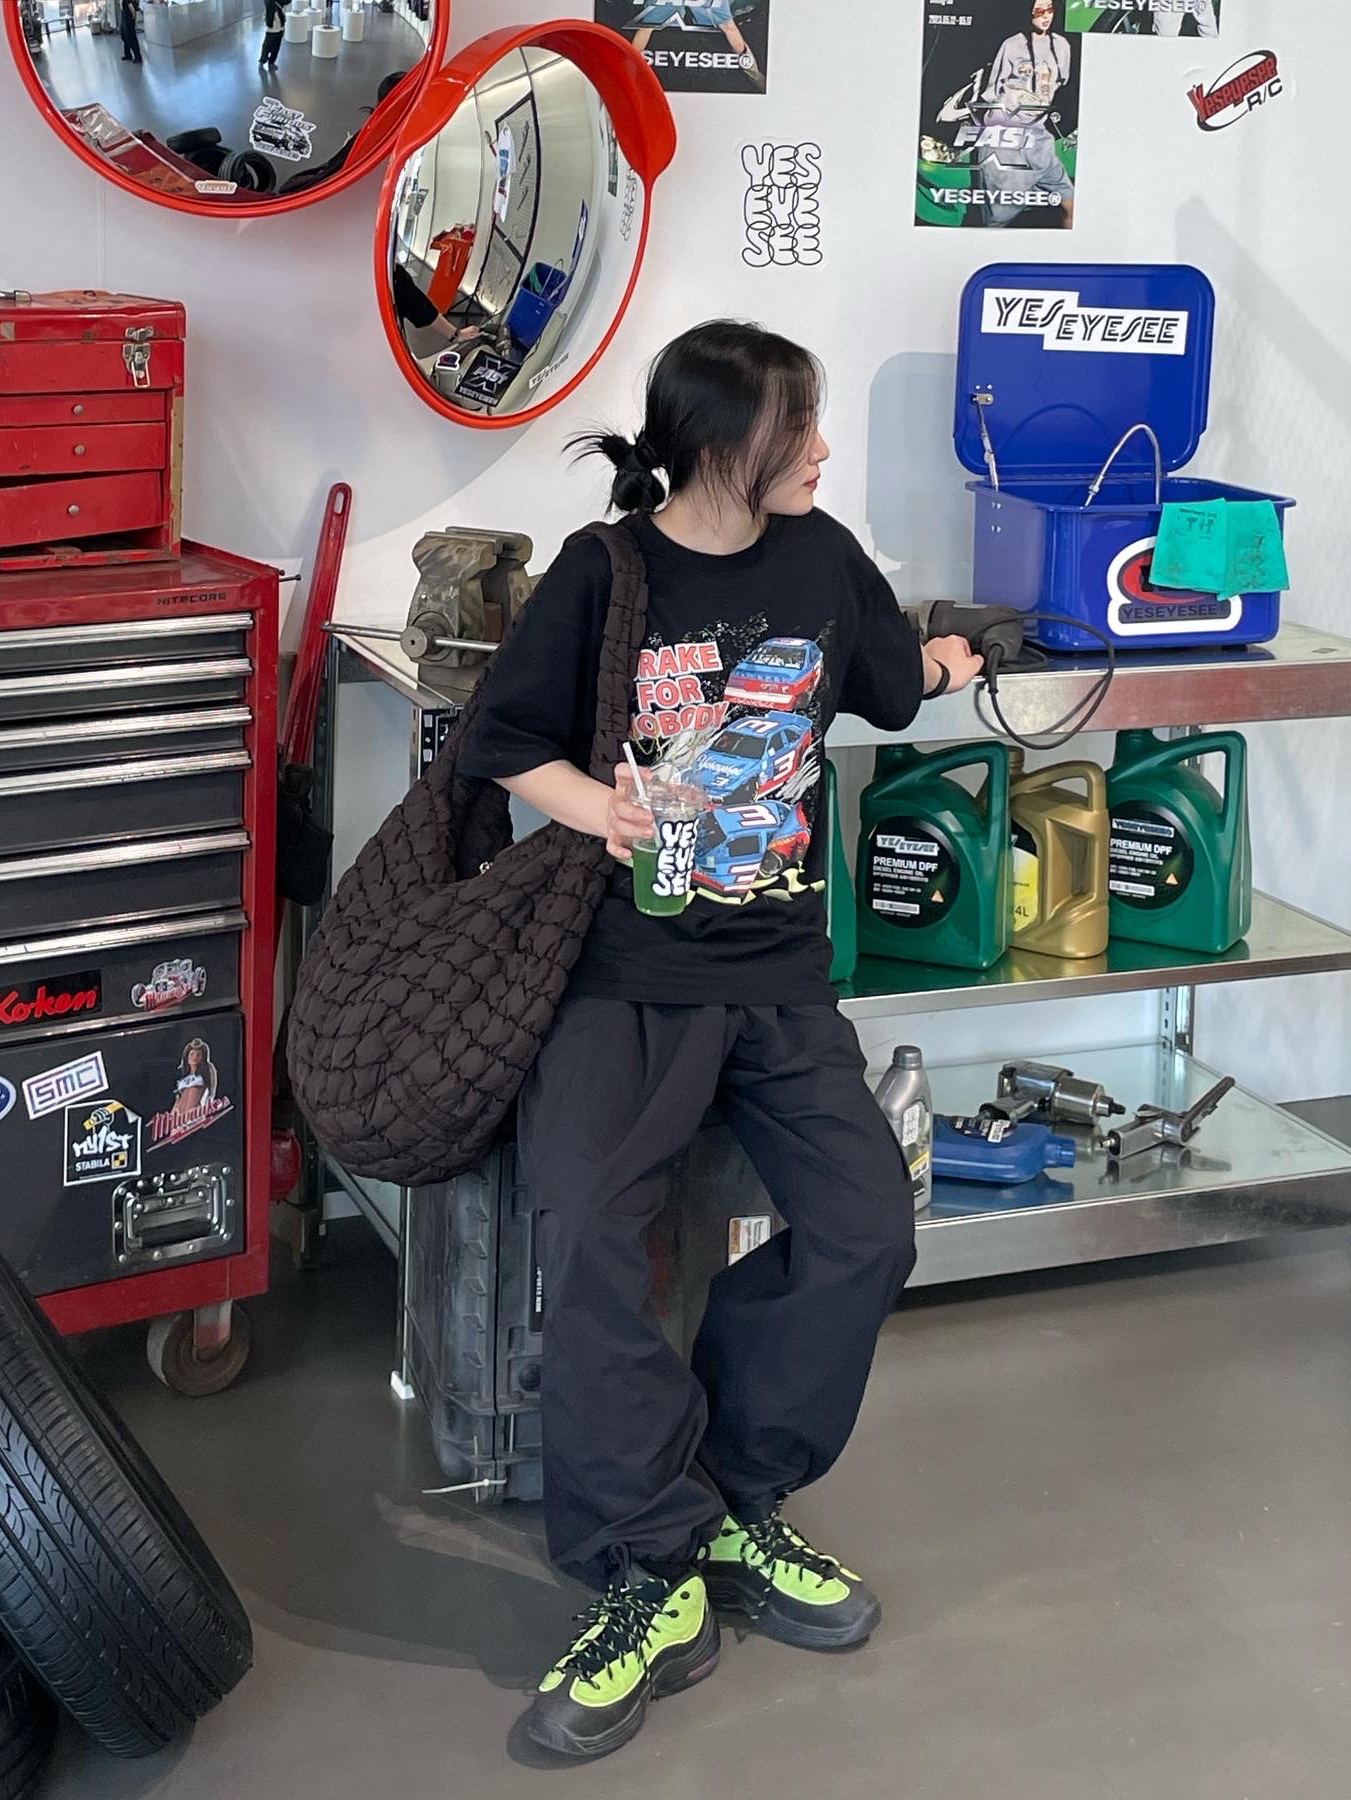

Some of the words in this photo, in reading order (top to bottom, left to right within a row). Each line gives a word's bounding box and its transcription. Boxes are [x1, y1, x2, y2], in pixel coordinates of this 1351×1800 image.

[1246, 77, 1283, 112] R/C
[953, 124, 1045, 149] FAST
[742, 142, 822, 191] YES
[743, 184, 821, 230] EYE
[742, 220, 823, 268] SEE
[636, 675, 705, 713] FOR
[873, 855, 918, 871] PREMIUM
[918, 860, 939, 873] DPF
[1110, 838, 1153, 853] PREMIUM
[1153, 843, 1173, 856] DPF
[75, 1158, 110, 1172] STABILA
